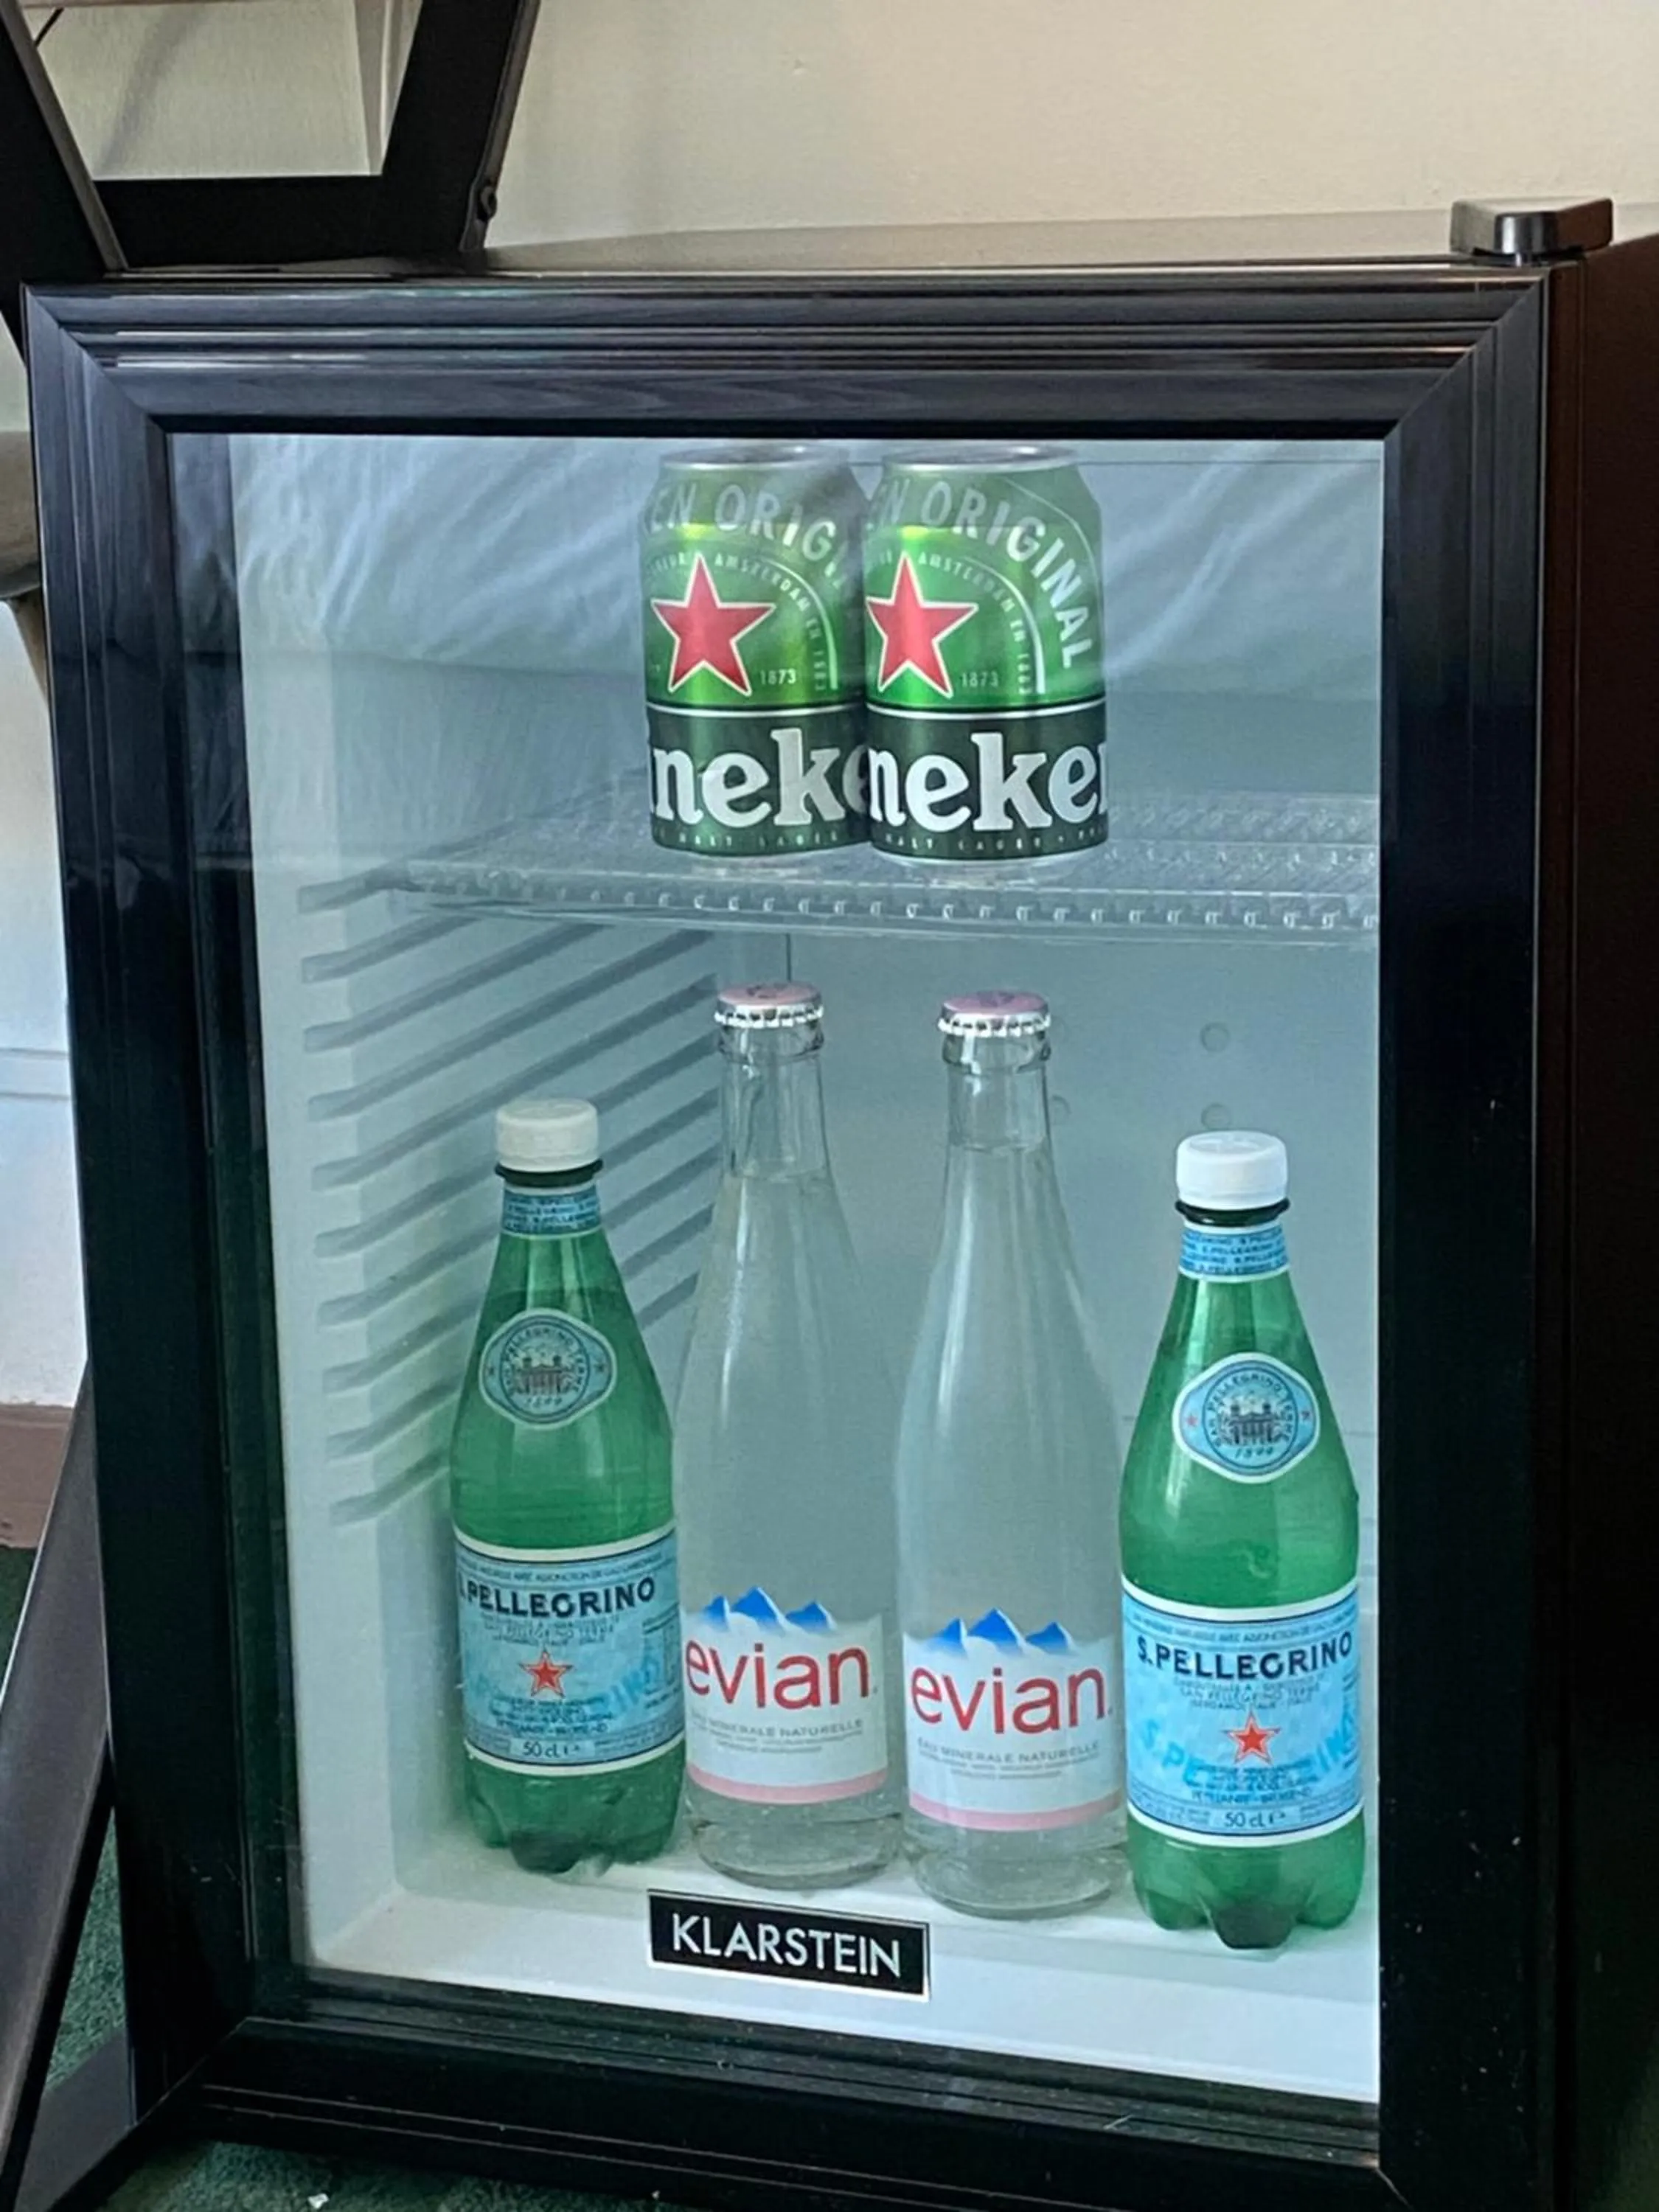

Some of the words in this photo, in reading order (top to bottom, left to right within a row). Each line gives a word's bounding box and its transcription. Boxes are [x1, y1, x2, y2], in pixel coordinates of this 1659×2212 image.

[918, 552, 1015, 613] AMSTERDAM
[922, 481, 1092, 669] ORIGINAL
[760, 668, 797, 686] 1873
[961, 671, 999, 688] 1873
[686, 1640, 869, 1710] evian
[1137, 1630, 1353, 1680] S.PELLEGRINO
[911, 1667, 1105, 1734] evian
[522, 1741, 542, 1757] 50
[1224, 1811, 1246, 1828] 50
[672, 1912, 901, 1978] KLARSTEIN
